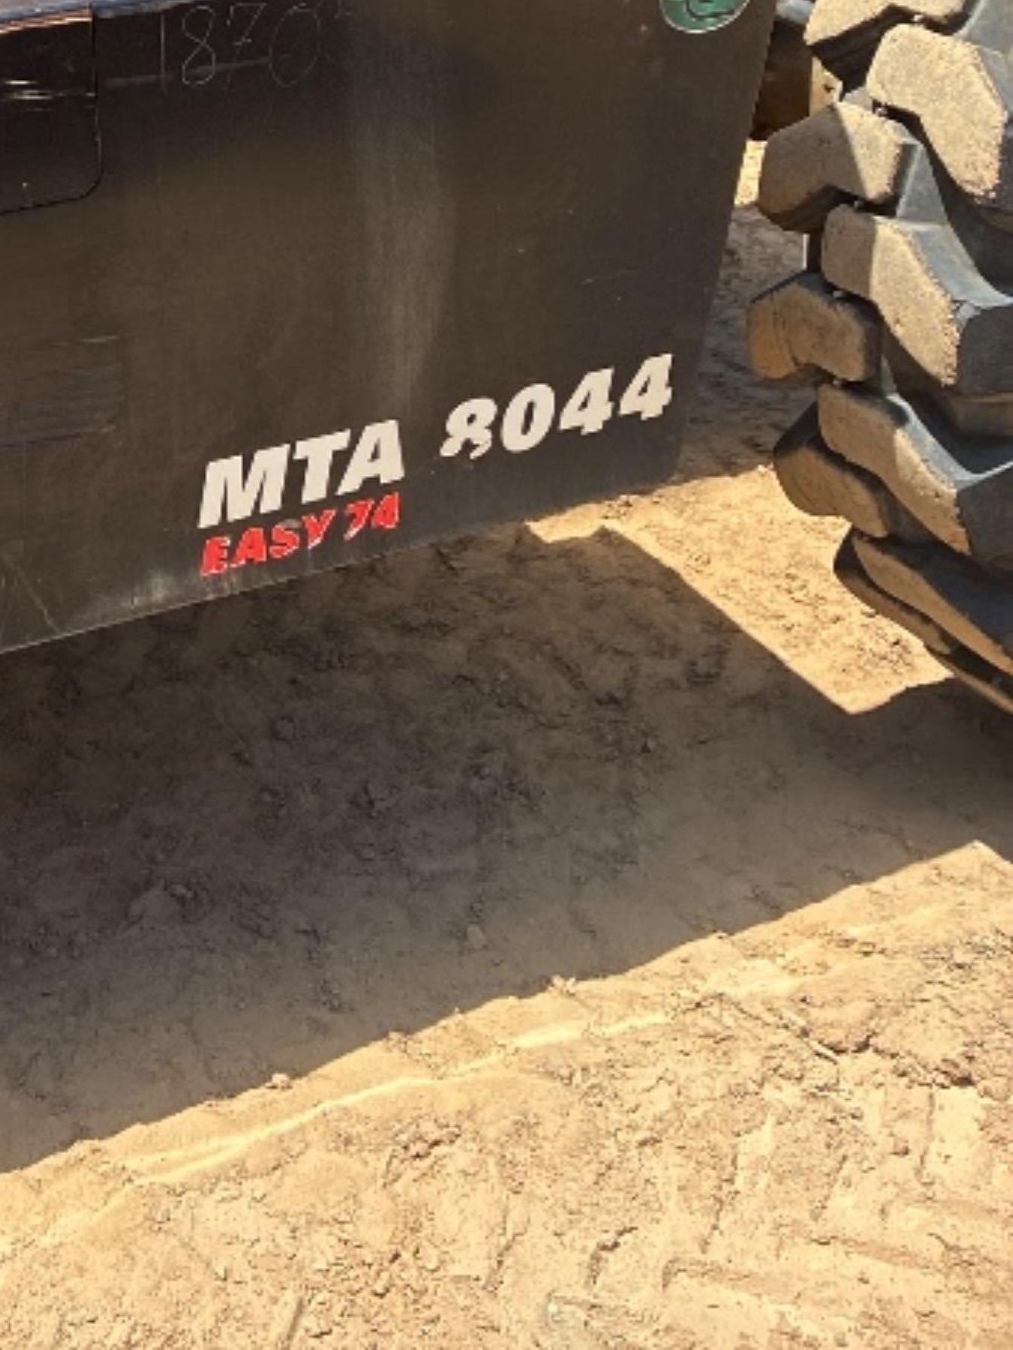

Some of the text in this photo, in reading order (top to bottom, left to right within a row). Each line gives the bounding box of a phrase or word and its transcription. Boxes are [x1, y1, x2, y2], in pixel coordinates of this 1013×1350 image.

[197, 353, 673, 529] MTA 8044
[200, 491, 400, 577] EASY 74
